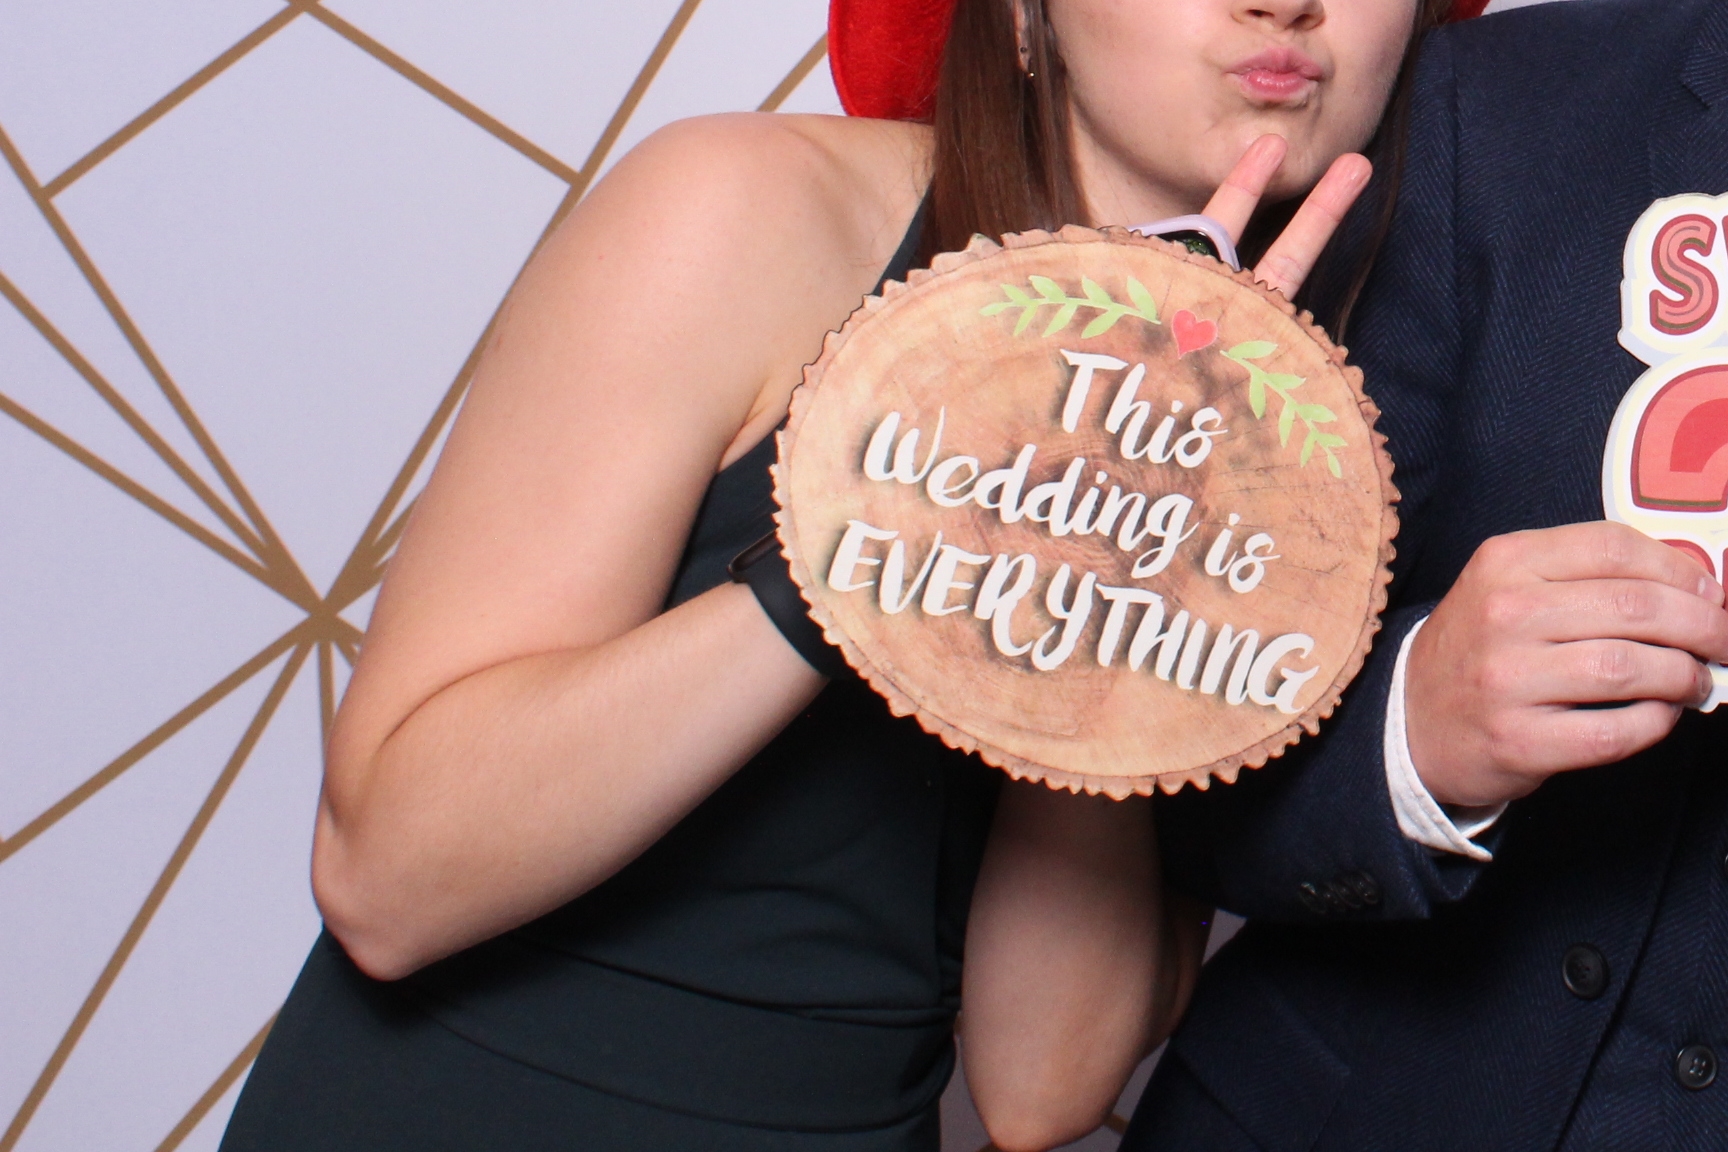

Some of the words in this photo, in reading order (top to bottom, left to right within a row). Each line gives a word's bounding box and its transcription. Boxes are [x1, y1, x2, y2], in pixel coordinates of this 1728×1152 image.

[1059, 348, 1229, 468] This
[862, 406, 1200, 580] Wedding
[1203, 512, 1281, 595] is
